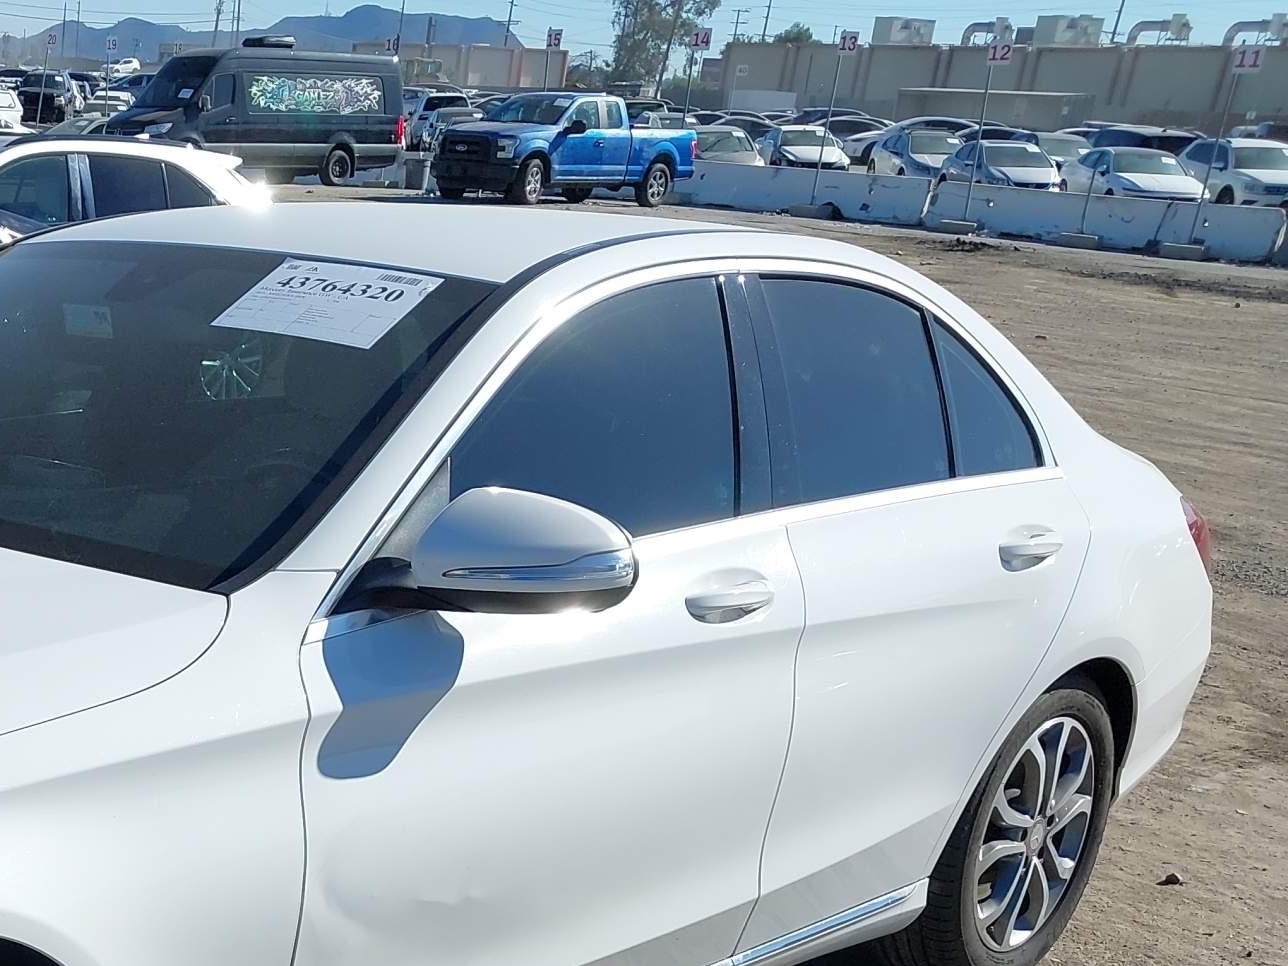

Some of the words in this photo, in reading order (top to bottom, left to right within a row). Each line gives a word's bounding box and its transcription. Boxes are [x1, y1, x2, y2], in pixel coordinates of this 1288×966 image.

[48, 34, 57, 44] 20
[107, 40, 117, 50] 19
[546, 33, 561, 47] 15
[692, 32, 710, 47] 14
[840, 36, 858, 51] 13
[988, 44, 1012, 61] 12
[1234, 50, 1261, 68] 11
[276, 275, 406, 302] 43764320
